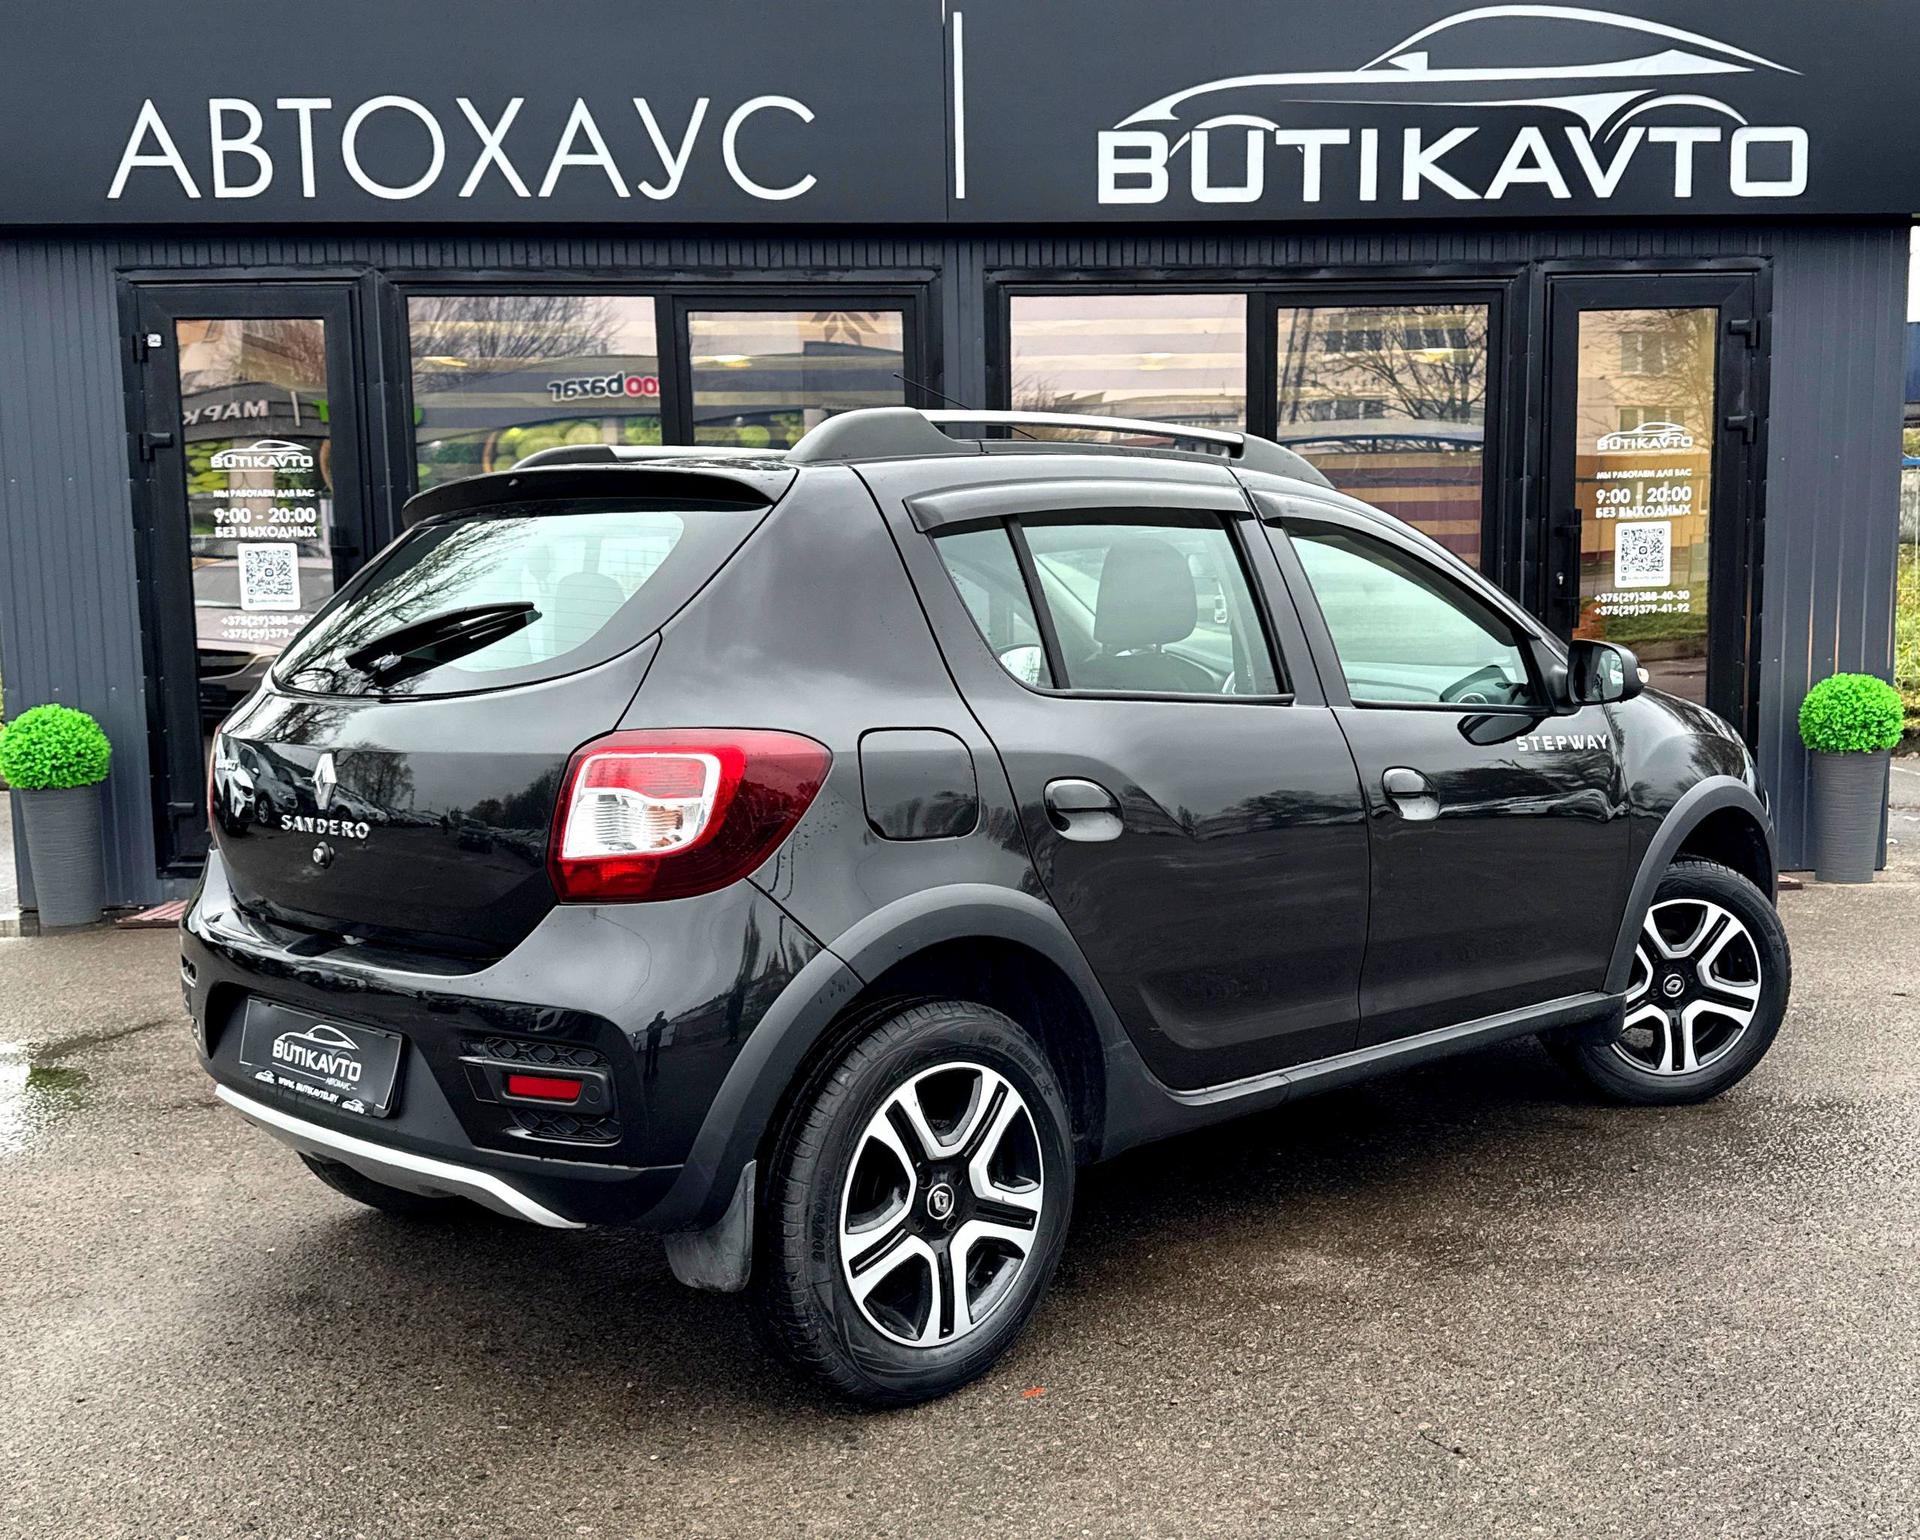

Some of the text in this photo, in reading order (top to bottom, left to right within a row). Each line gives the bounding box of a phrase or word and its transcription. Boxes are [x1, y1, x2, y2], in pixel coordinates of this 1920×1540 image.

[107, 94, 818, 201] АВТОХАУС
[1097, 126, 1809, 204] BUTIKAVTO
[1596, 436, 1694, 450] BUTIKAVTO
[210, 454, 314, 468] BUTIKAVTO
[1674, 468, 1693, 477] ВАС
[296, 488, 316, 498] ВАС
[1595, 488, 1631, 505] 9:00
[1646, 486, 1692, 502] 20:00
[213, 507, 251, 524] 9:00
[268, 507, 317, 524] 20:00
[1595, 504, 1692, 519] БЕЗ ВЫХОДНЫХ
[214, 526, 318, 539] БЕЗ ВЫХОДНЫХ
[1516, 734, 1608, 752] STEPWAY
[280, 814, 371, 840] SANDERO
[272, 1039, 362, 1082] BUTIKAVTO
